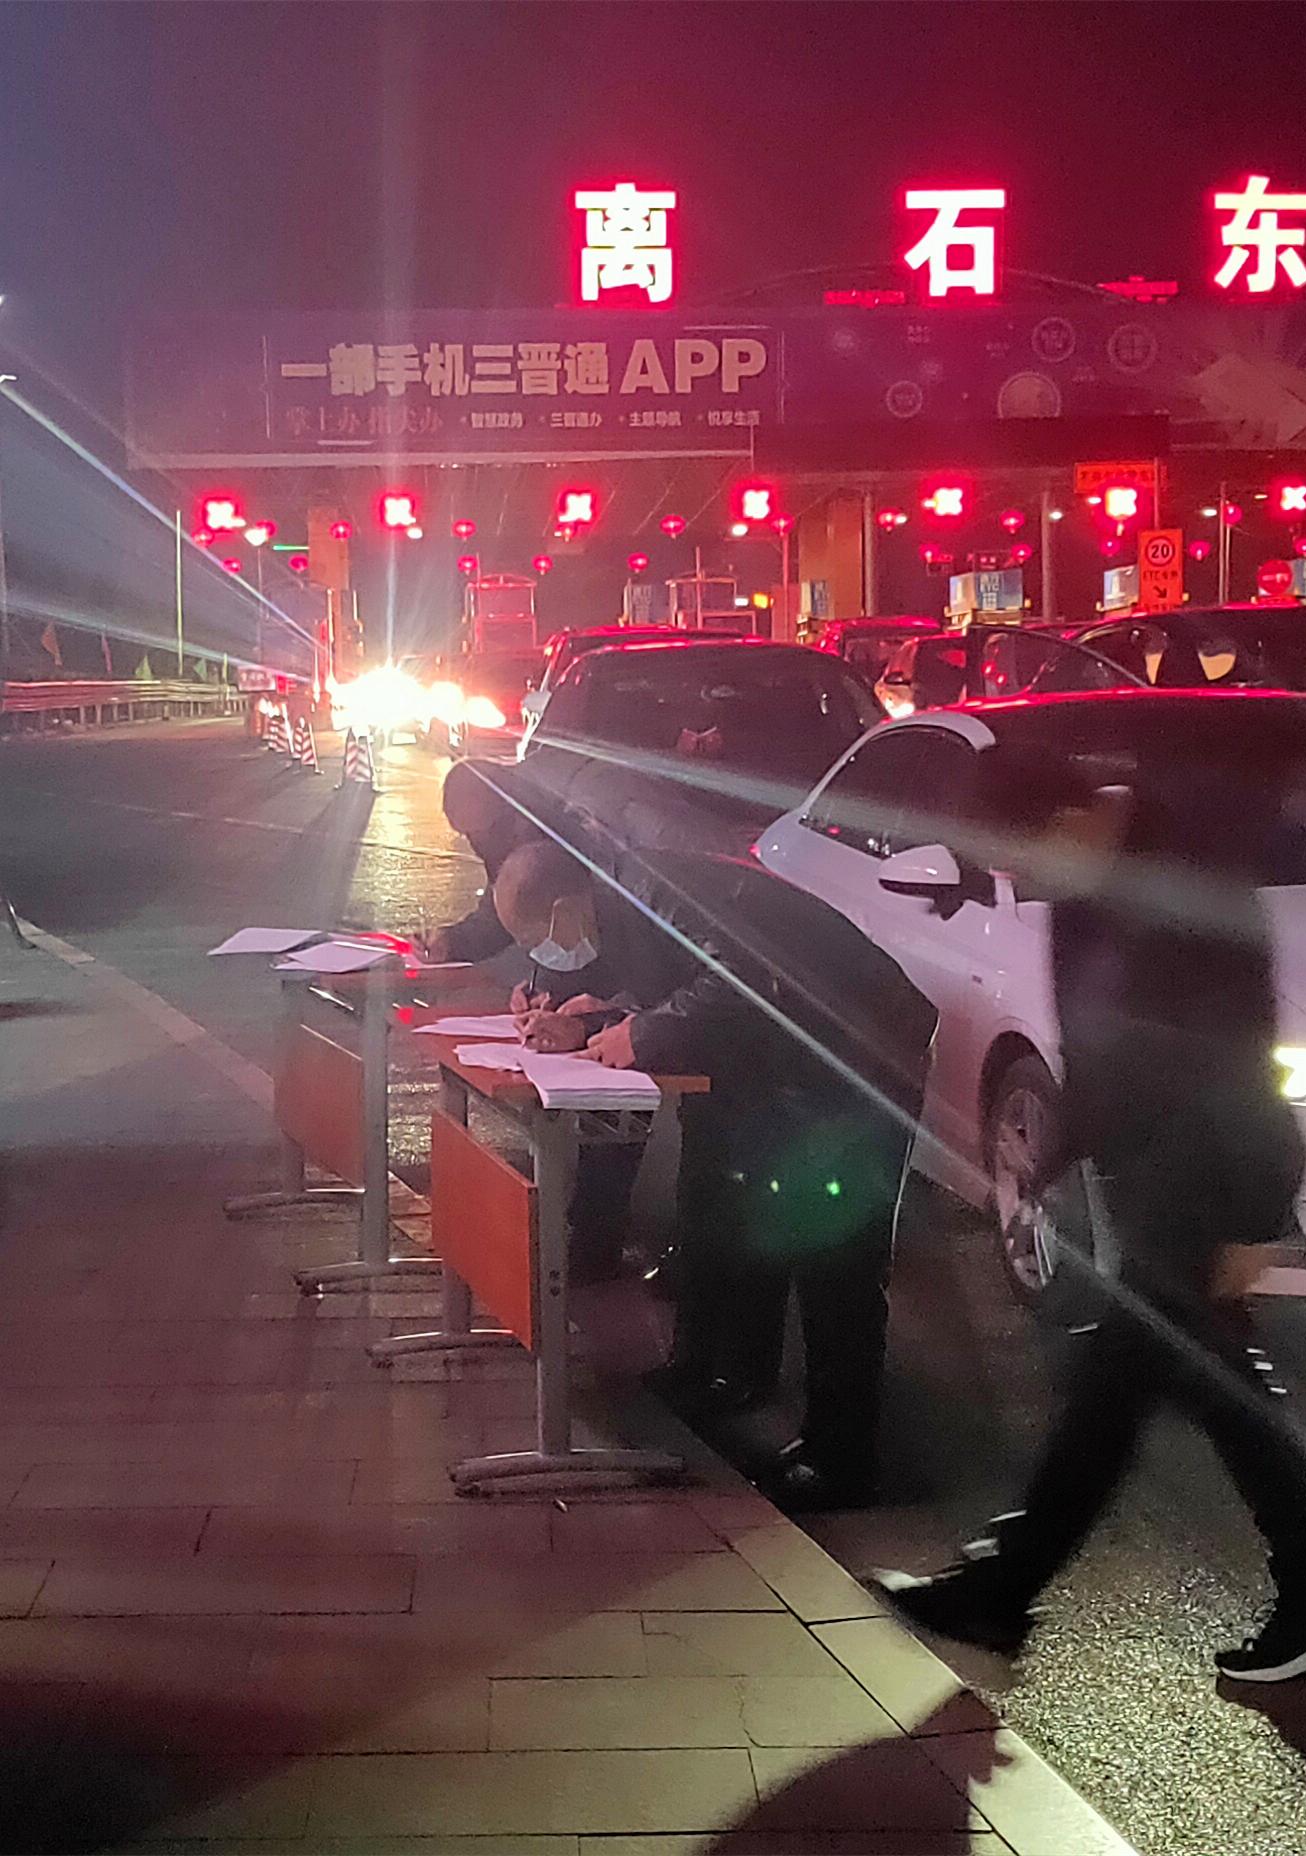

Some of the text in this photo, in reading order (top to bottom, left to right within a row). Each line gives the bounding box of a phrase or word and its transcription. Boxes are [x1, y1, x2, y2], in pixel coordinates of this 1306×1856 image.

[280, 338, 767, 398] 一部手机三晋通APP
[1151, 544, 1170, 559] 20
